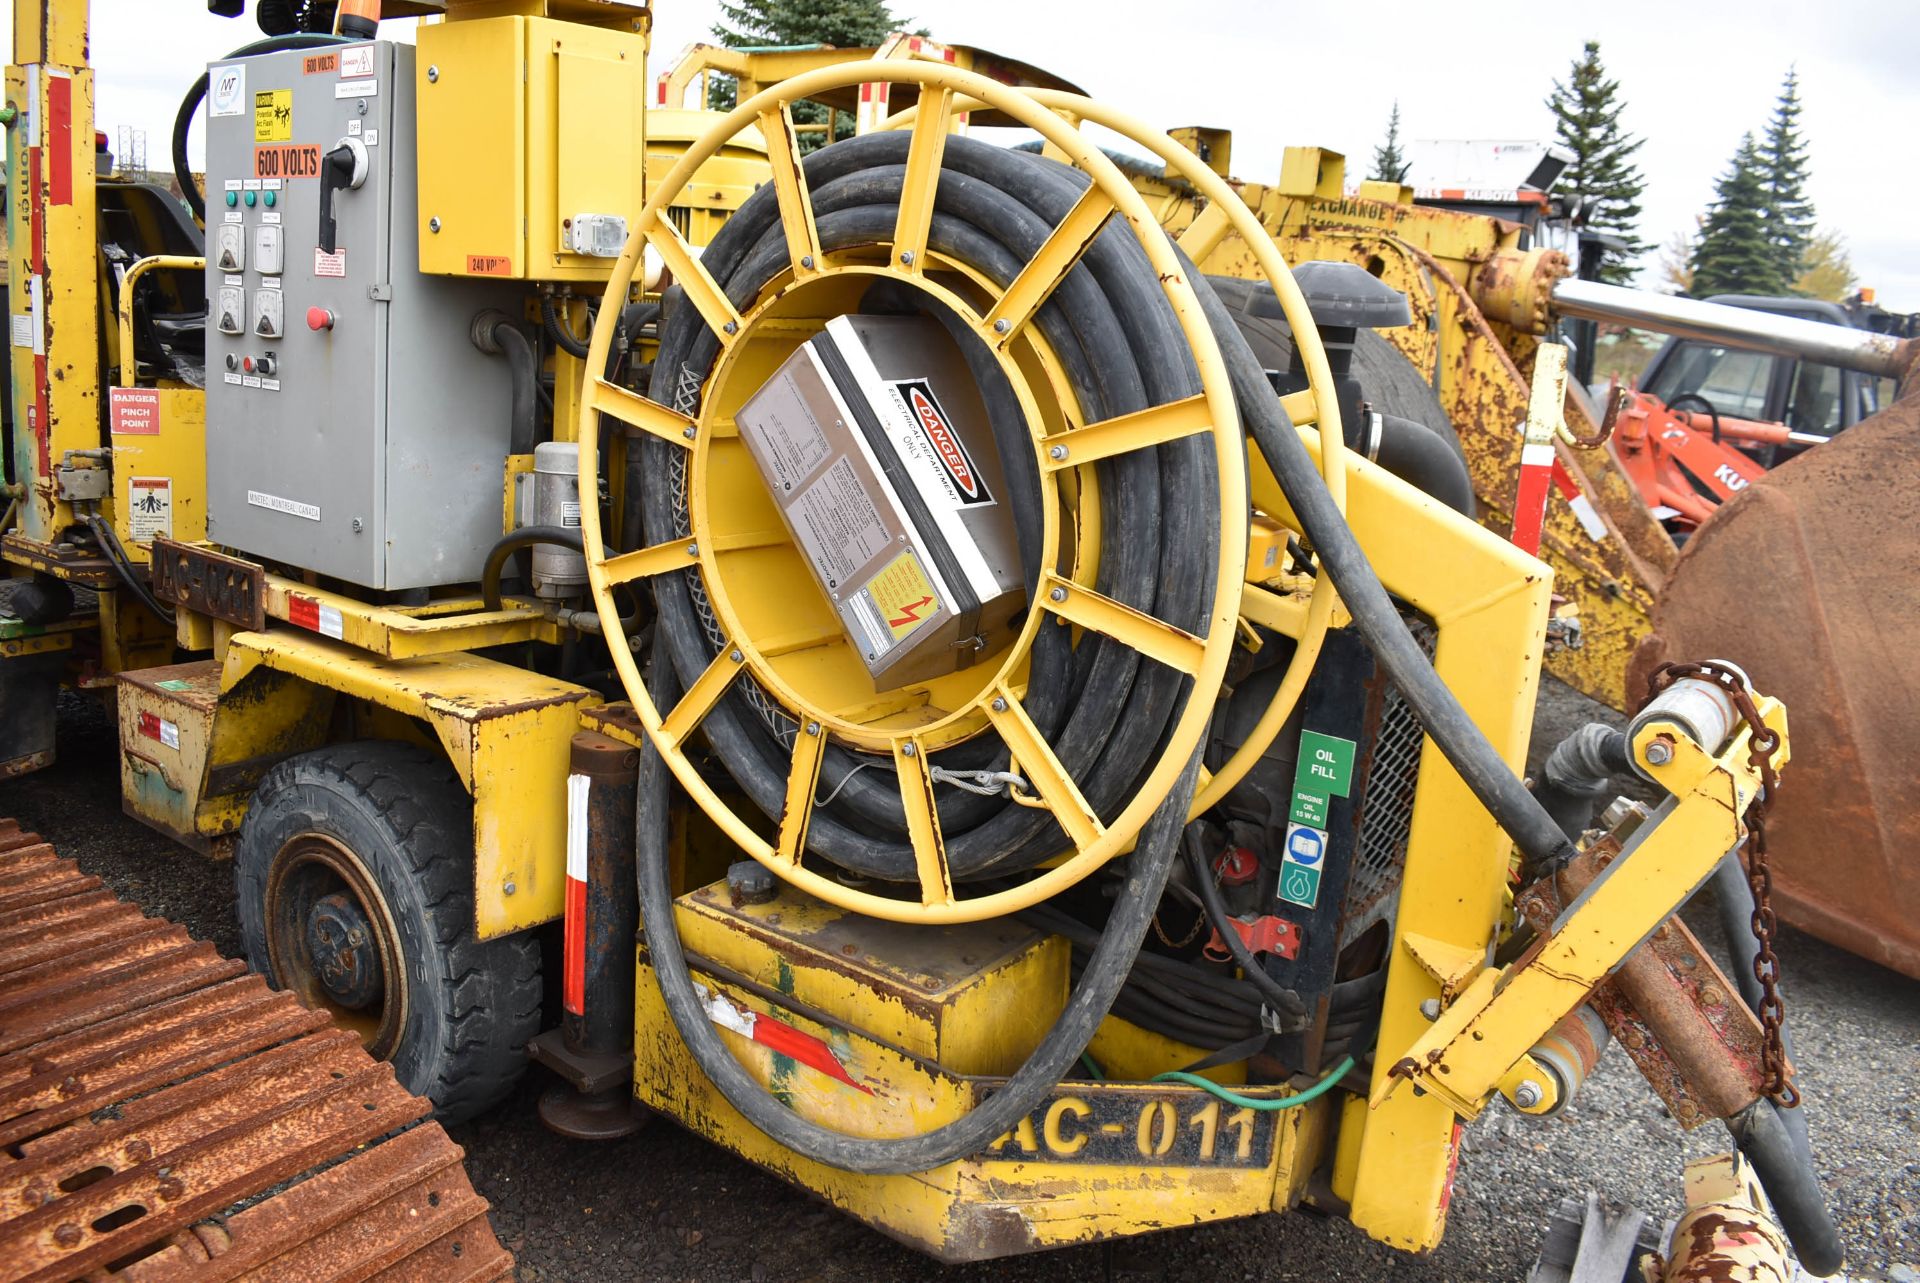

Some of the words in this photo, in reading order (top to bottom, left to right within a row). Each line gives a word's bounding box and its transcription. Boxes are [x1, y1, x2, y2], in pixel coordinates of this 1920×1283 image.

[307, 59, 317, 73] 600
[318, 56, 334, 72] VOLTS
[350, 124, 359, 132] OFF
[367, 134, 376, 142] ON
[258, 150, 278, 176] 600
[282, 148, 317, 175] VOLTS
[1464, 190, 1518, 201] KUBOTA
[472, 258, 484, 271] 240
[113, 394, 157, 404] DANGER
[121, 408, 150, 417] PINCH
[122, 420, 150, 428] POINT
[888, 388, 921, 440] ELECTRICAL
[919, 442, 958, 501] DEPARTMENT
[903, 436, 922, 460] ONLY
[920, 406, 968, 478] DANGER
[1315, 749, 1336, 763] OIL
[1311, 764, 1336, 780] FILL
[1297, 792, 1324, 805] ENGINE
[1303, 803, 1315, 812] OIL
[1295, 810, 1303, 818] 15
[1304, 812, 1312, 820] W
[1312, 814, 1321, 822] 40
[987, 1097, 1255, 1160] AC-011
